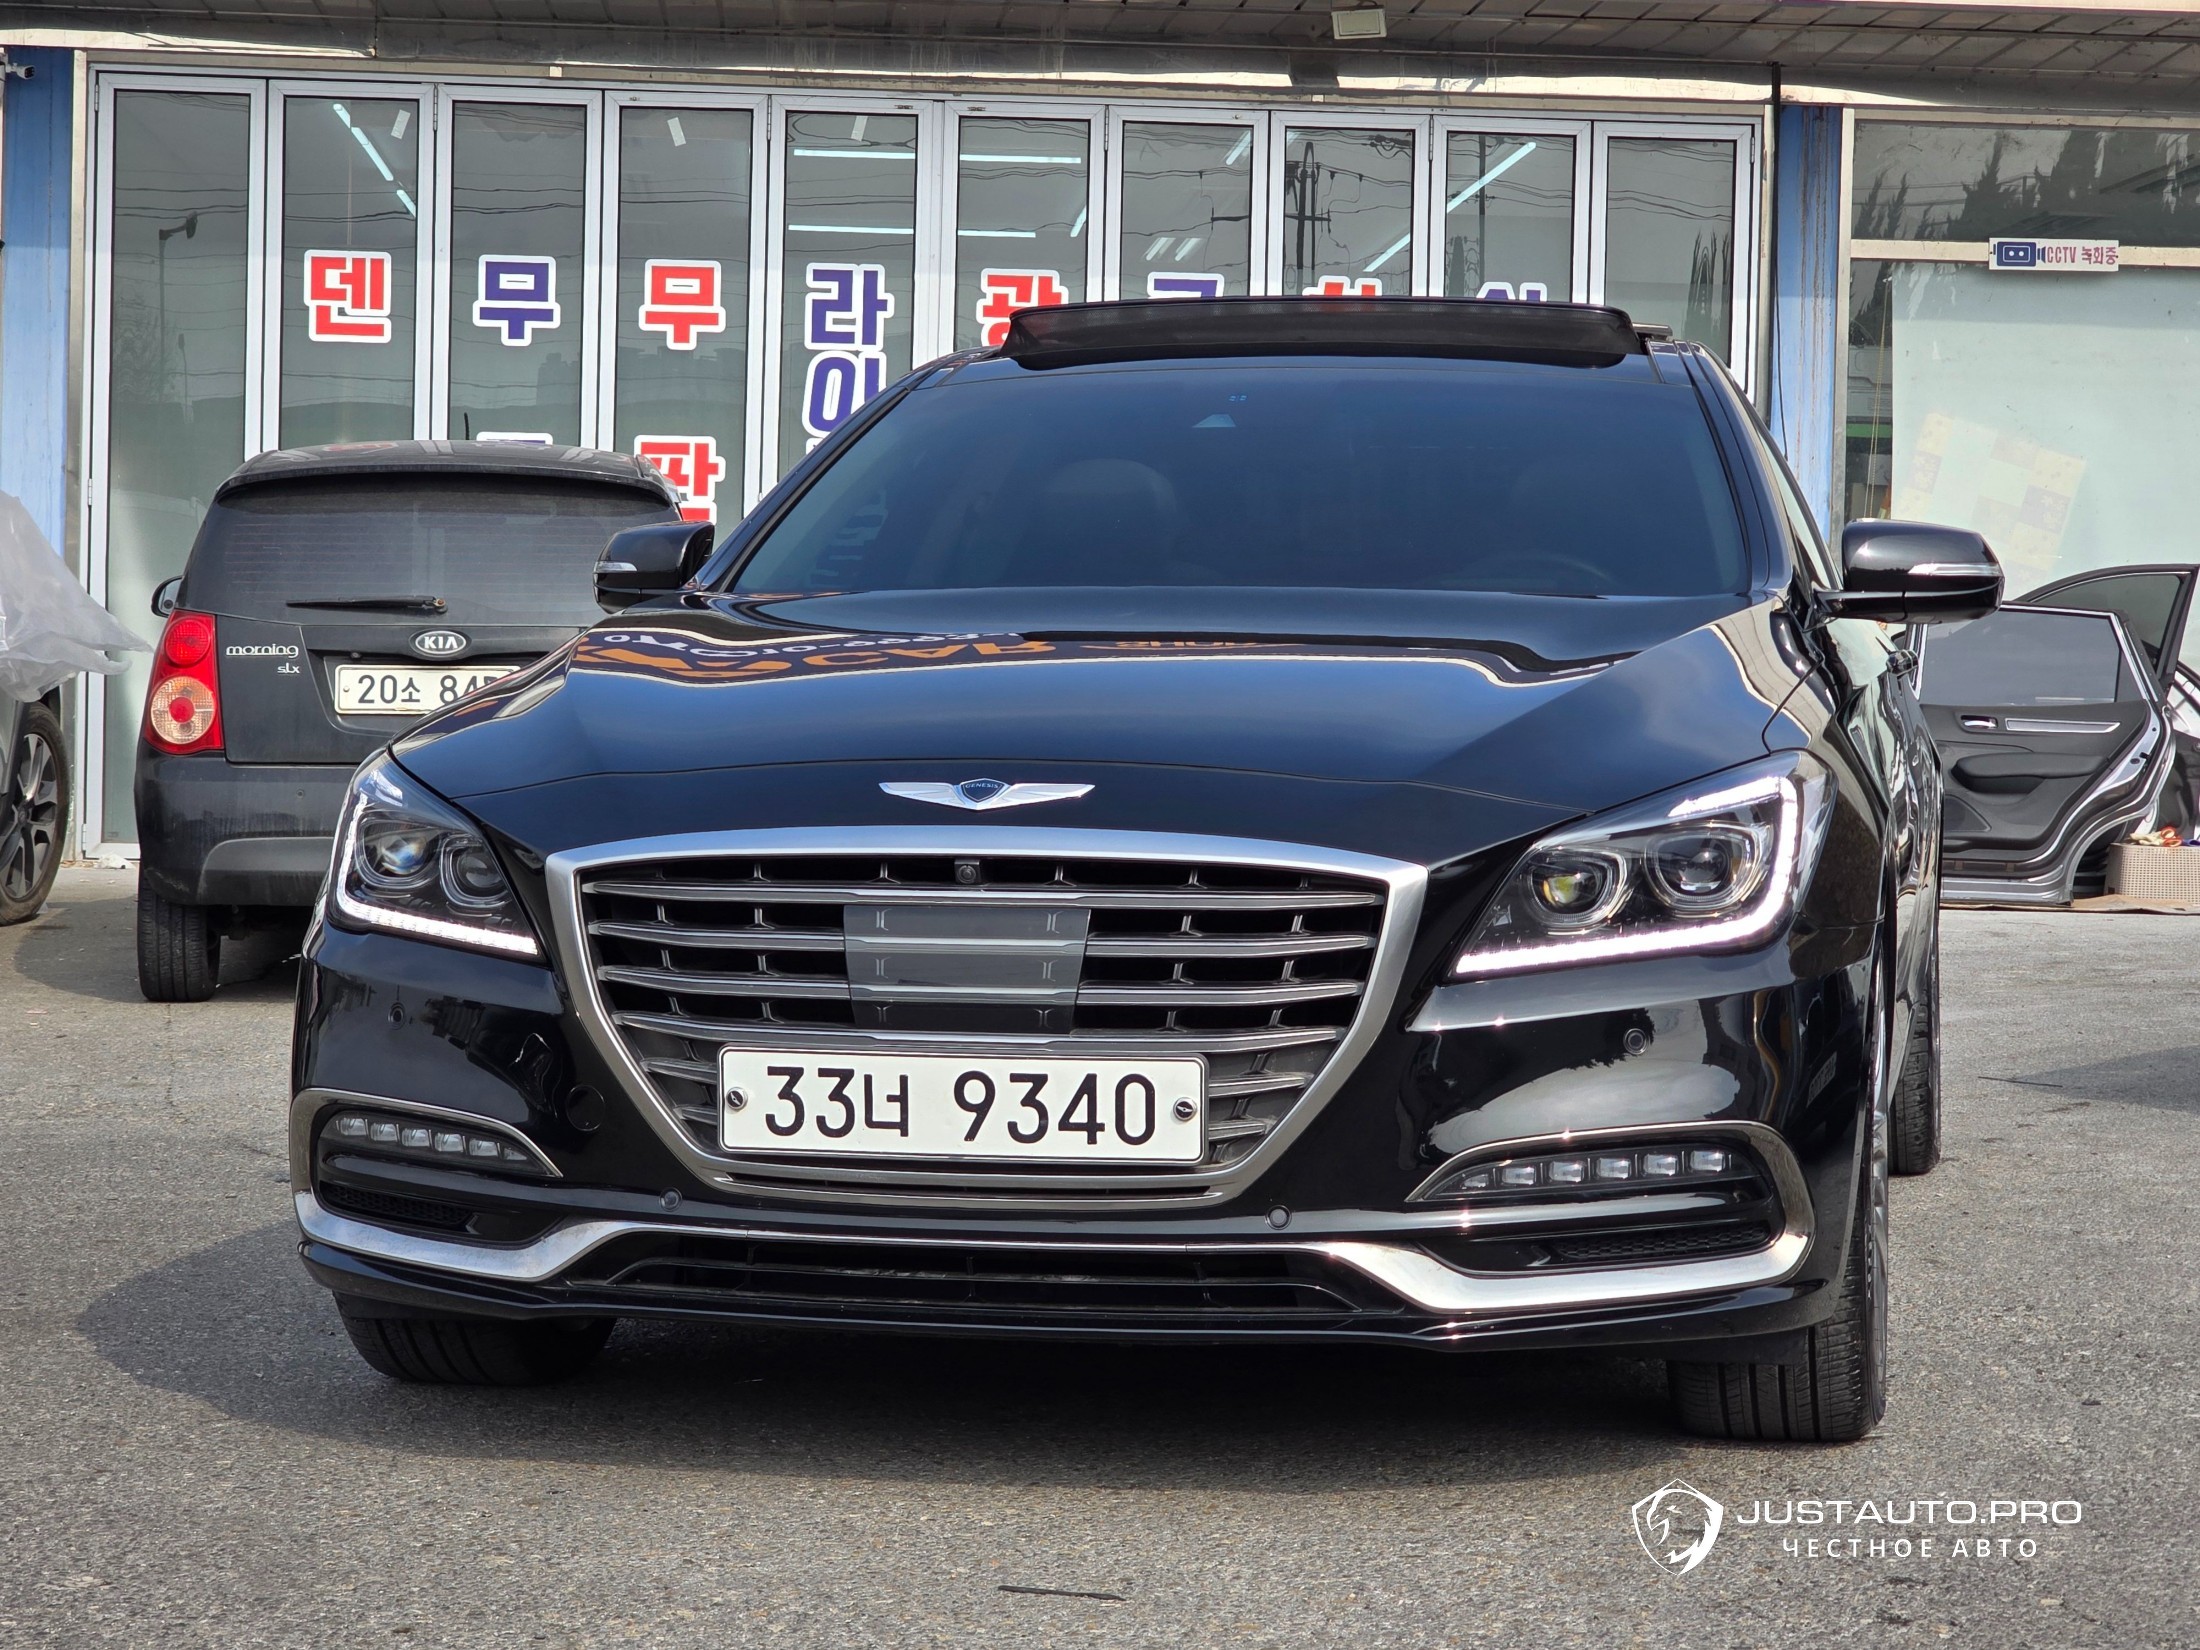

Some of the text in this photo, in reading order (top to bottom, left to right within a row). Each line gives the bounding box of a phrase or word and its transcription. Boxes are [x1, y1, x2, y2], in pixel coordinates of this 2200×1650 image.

[2046, 246, 2077, 264] CCTV
[226, 643, 299, 658] morning
[423, 635, 459, 650] KIA
[357, 674, 421, 704] 20소
[765, 1065, 1157, 1146] 33너 9340
